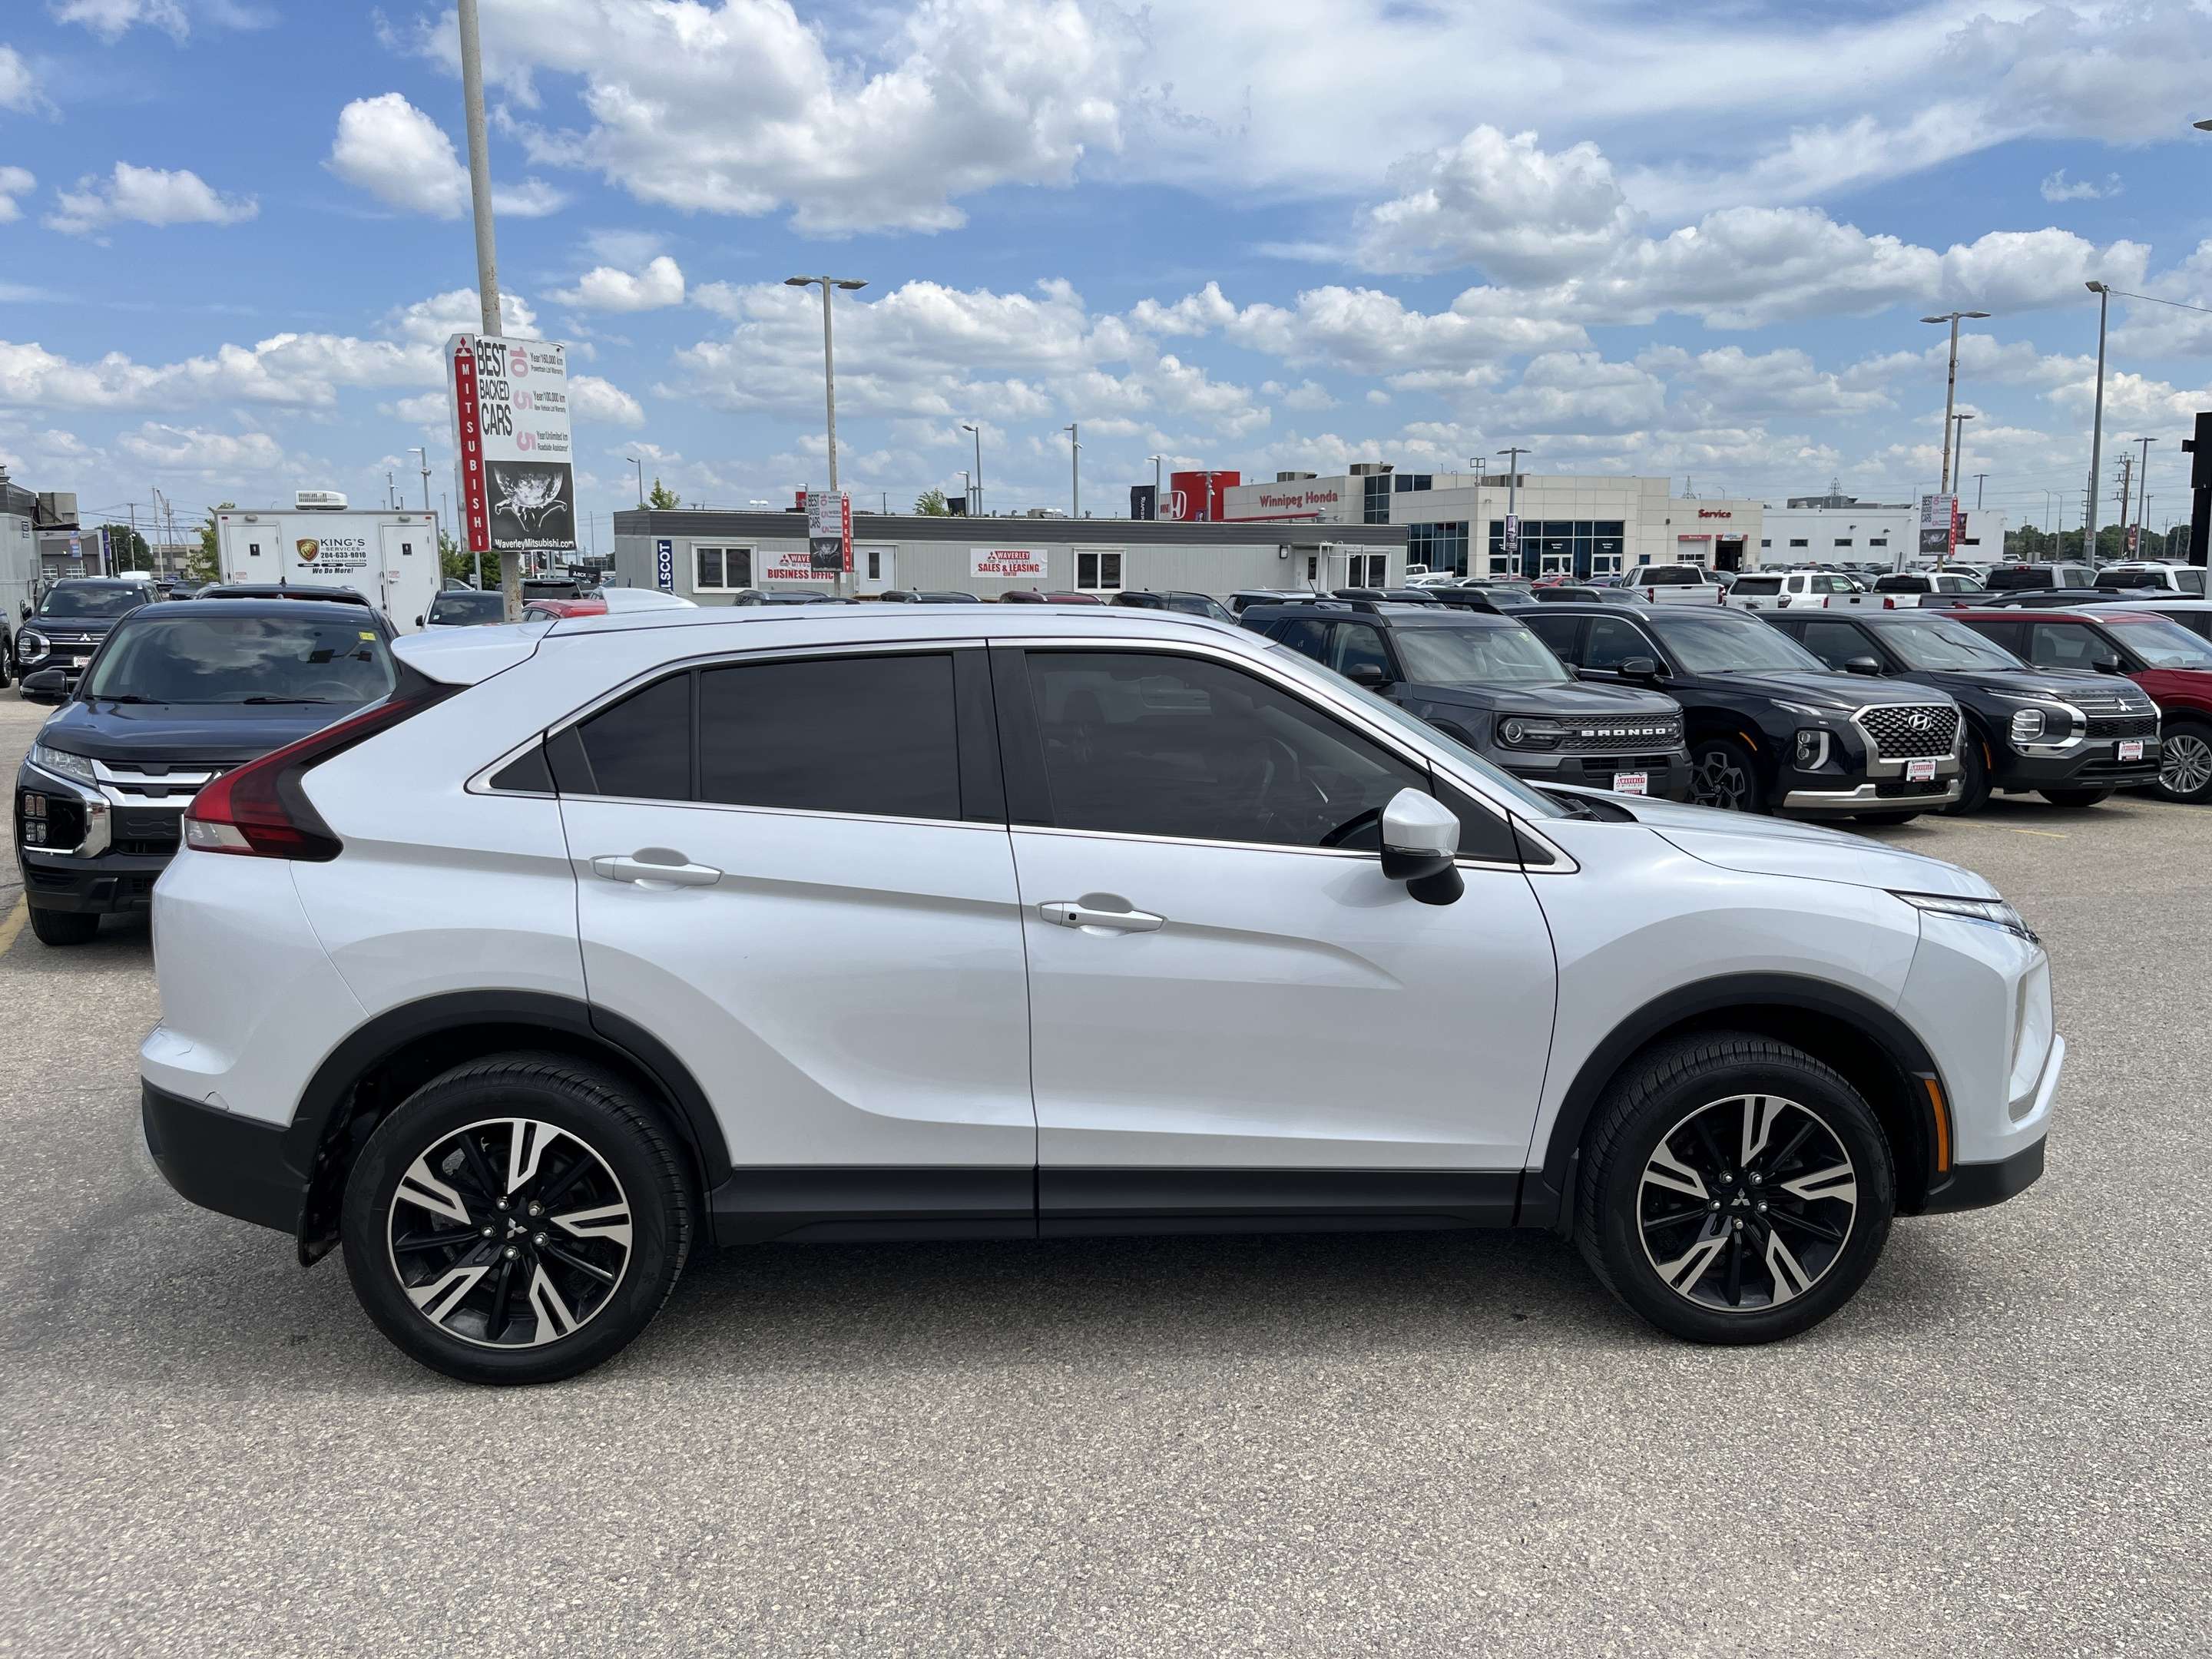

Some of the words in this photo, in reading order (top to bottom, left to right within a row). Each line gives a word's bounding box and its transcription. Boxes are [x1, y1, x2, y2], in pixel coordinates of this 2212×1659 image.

[476, 341, 507, 377] BEST
[480, 379, 510, 401] BACKED
[482, 404, 512, 436] CARS
[462, 363, 482, 546] MITSUBISHI
[1260, 494, 1303, 509] Winnipeg
[1306, 489, 1338, 504] Honda
[1698, 508, 1731, 518] Service
[495, 538, 575, 550] WaverleyMitsubishi.com
[659, 543, 671, 588] LSCOT
[791, 555, 810, 563] WAVE
[767, 569, 809, 578] BUSINESS
[1009, 564, 1039, 572] LEASING
[1581, 728, 1665, 737] BRONCO
